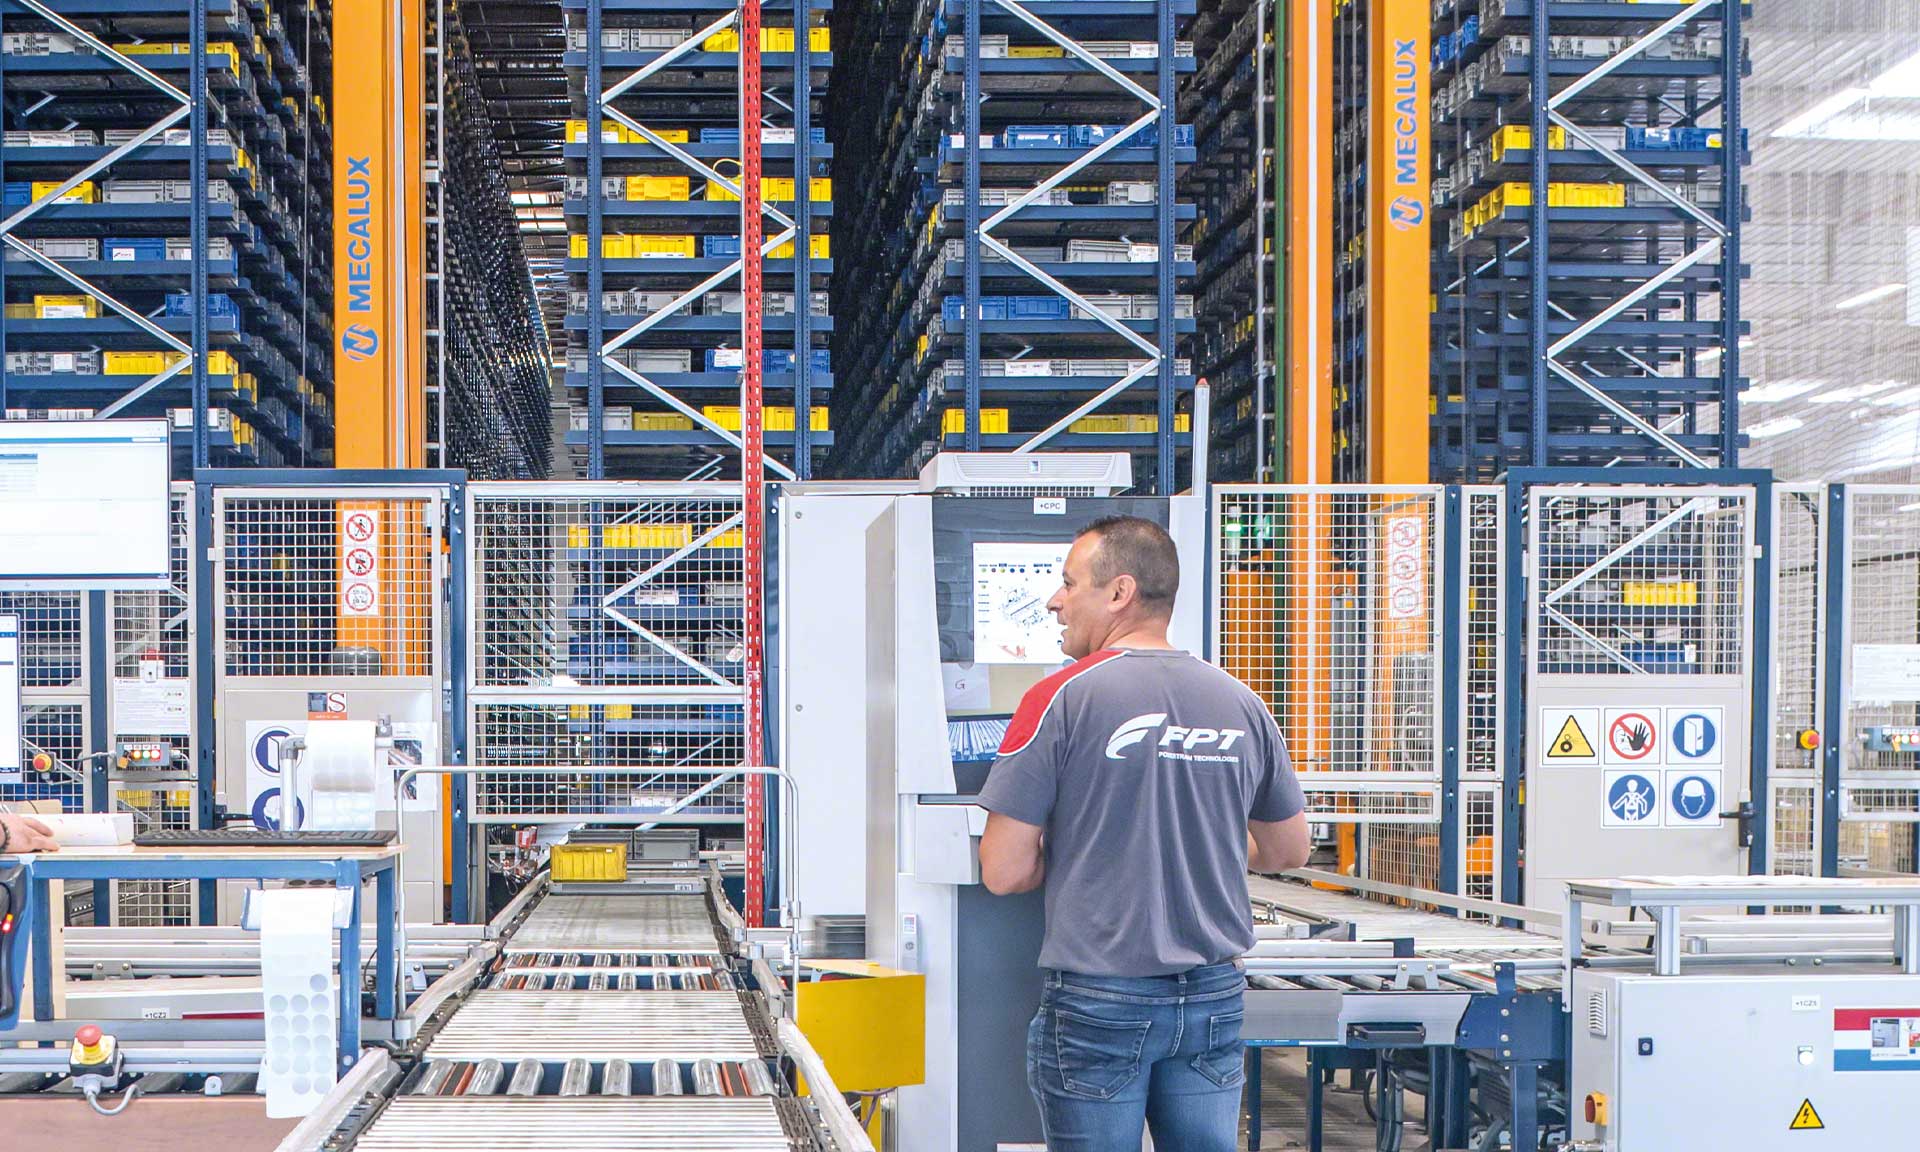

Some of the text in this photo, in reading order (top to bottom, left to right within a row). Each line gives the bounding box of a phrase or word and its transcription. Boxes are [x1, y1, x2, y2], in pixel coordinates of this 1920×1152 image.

[1396, 40, 1416, 184] MECALUX
[348, 156, 371, 312] MECALUX
[1158, 725, 1245, 750] FPT
[1193, 754, 1239, 763] TECHNOLOGIES
